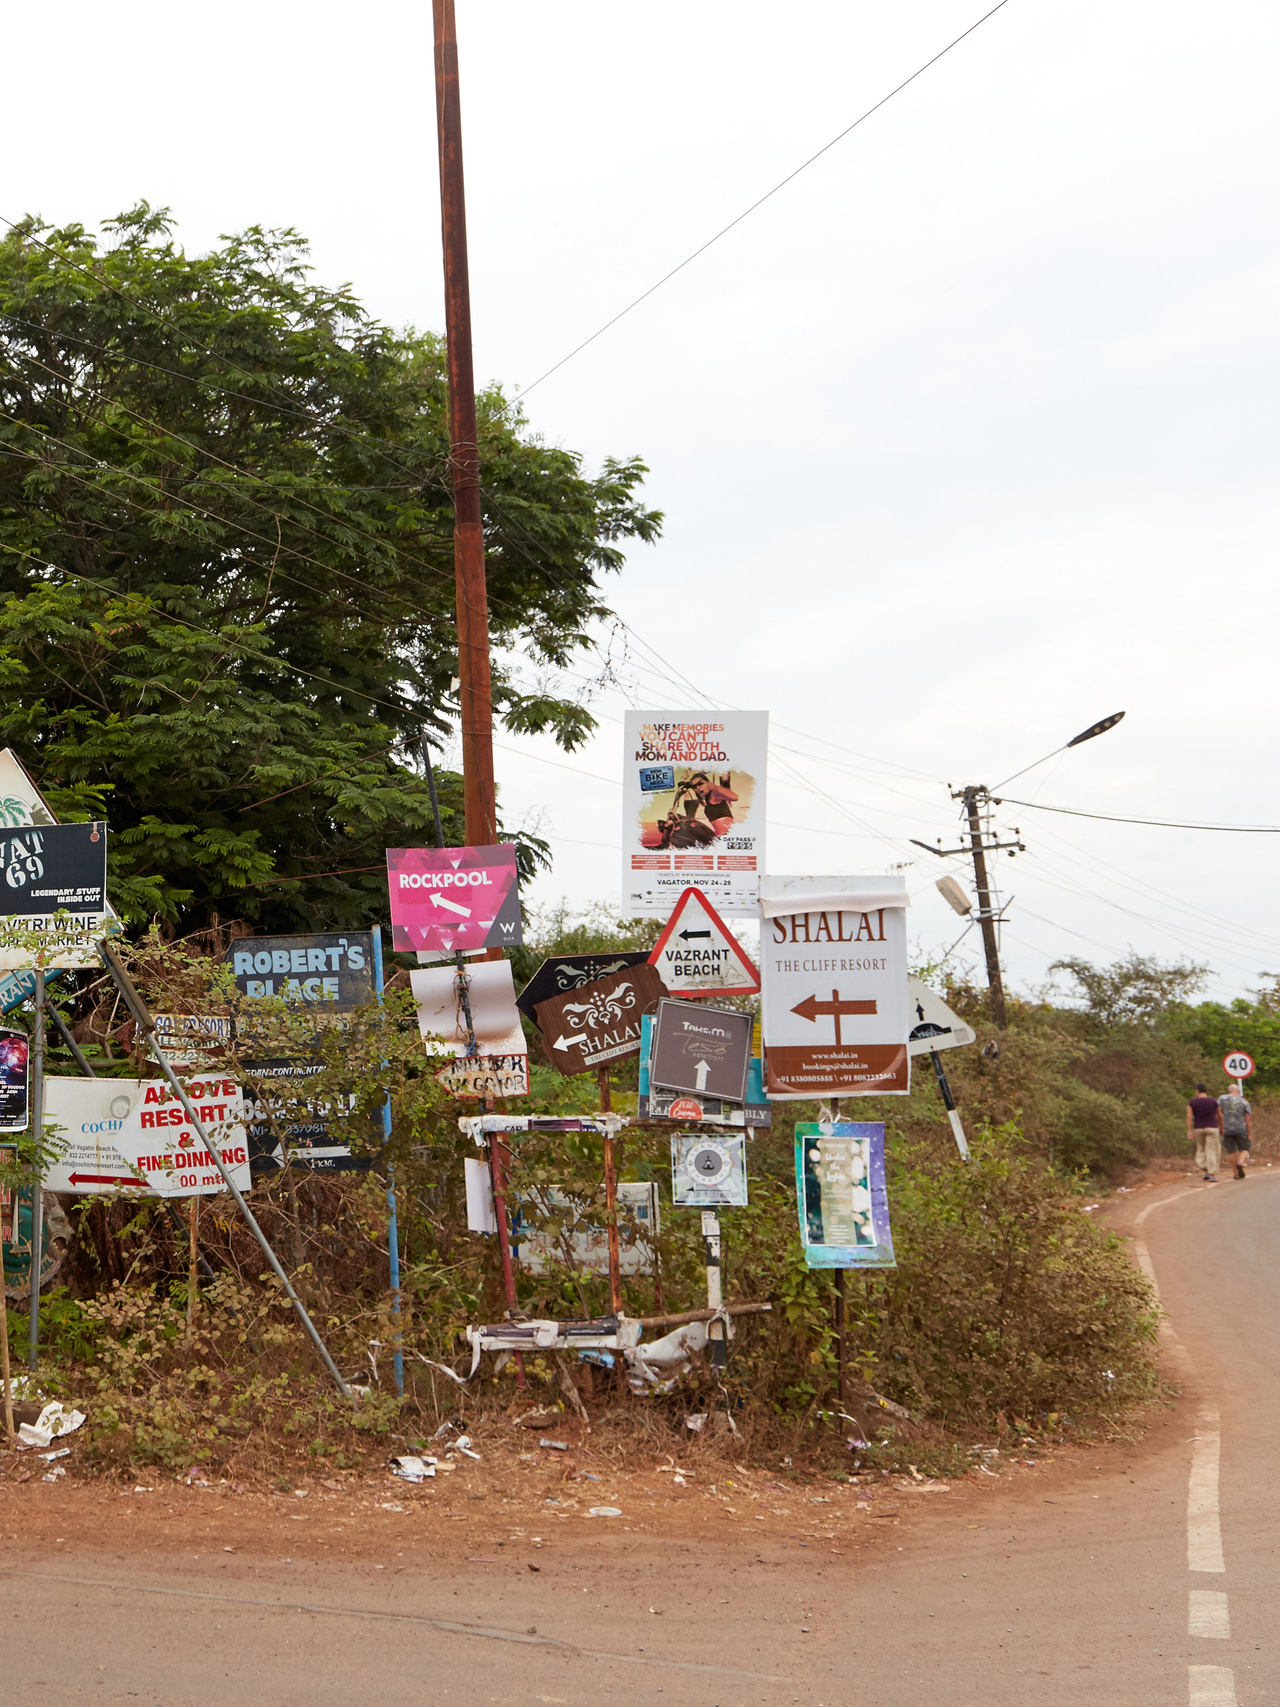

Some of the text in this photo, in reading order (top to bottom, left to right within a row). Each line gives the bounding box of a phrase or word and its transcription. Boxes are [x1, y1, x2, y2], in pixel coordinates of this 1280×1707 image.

[642, 723, 725, 732] MAKE MEMORIES
[638, 731, 709, 741] YOU CAN'T
[641, 741, 720, 752] SHARE WITH
[635, 751, 730, 762] MOM AND DAD.
[645, 772, 668, 782] BIKE
[6, 855, 45, 888] 69
[399, 871, 493, 888] ROCKPOOL
[31, 887, 101, 897] LEGENDARY STUFF
[84, 894, 101, 902] OUT
[500, 922, 515, 933] W
[773, 908, 887, 944] SHALAI
[233, 938, 365, 975] ROBERT'S
[666, 949, 730, 961] VAZRANT
[674, 964, 721, 976] BEACH
[776, 958, 887, 972] THE CLIFF RESORT
[246, 977, 340, 1001] PLACE
[579, 1022, 641, 1055] SHALAI
[802, 1062, 868, 1071] bookings@shalai.in
[1229, 1058, 1248, 1070] 40
[140, 1104, 228, 1129] RESORT
[178, 1132, 195, 1148] &
[175, 1147, 246, 1170] DINNNG
[826, 1153, 845, 1161] Under
[830, 1162, 840, 1170] the
